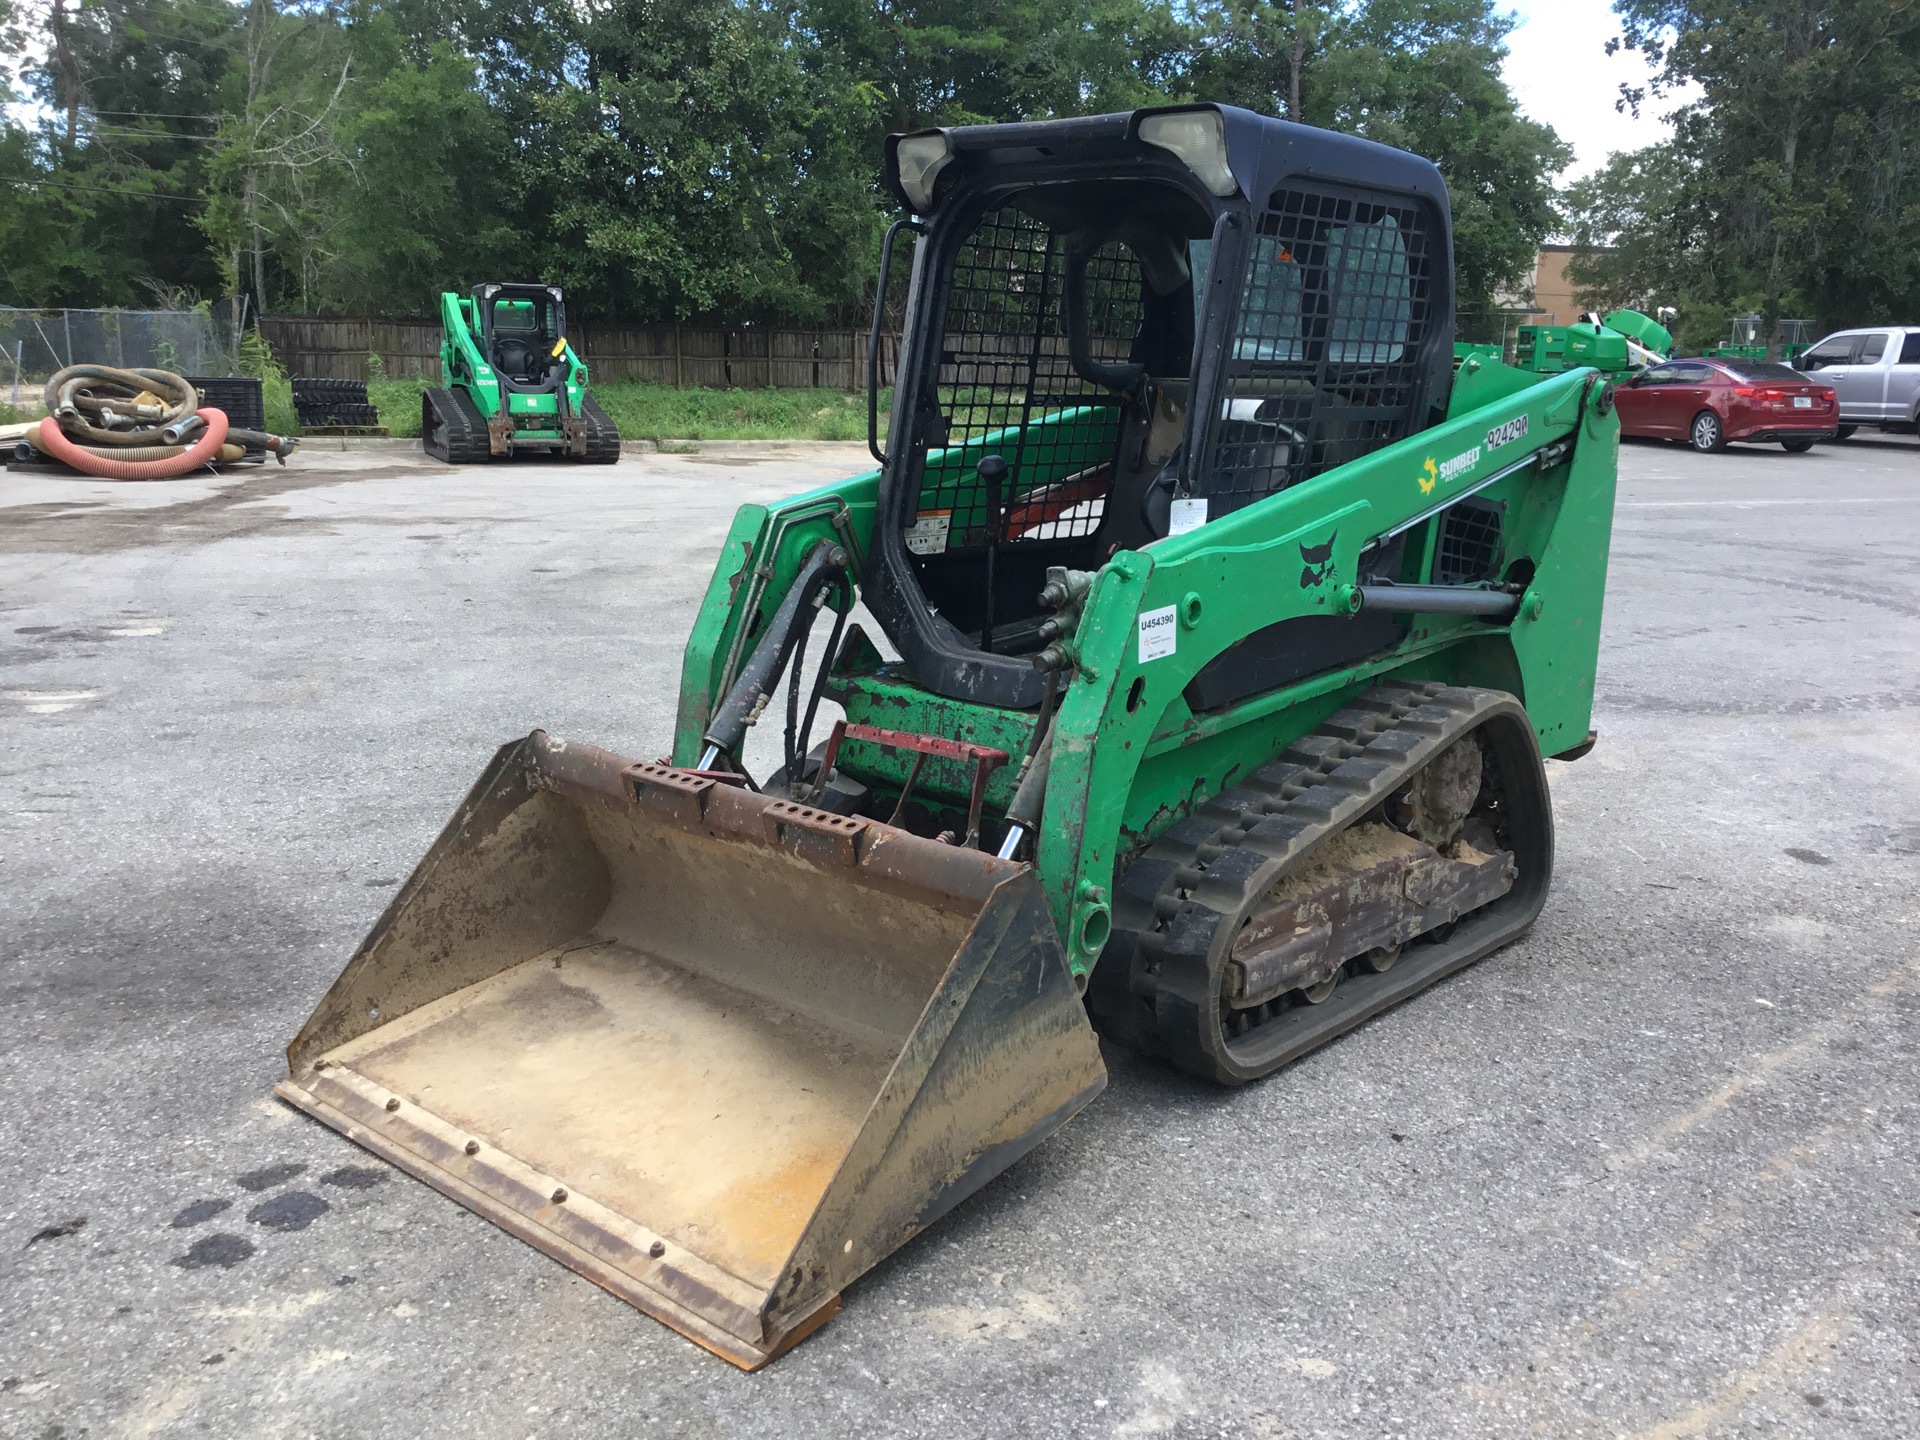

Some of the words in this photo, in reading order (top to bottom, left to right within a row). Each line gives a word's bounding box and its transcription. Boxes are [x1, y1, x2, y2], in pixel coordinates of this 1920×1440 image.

[1439, 445, 1482, 480] SUNBELT
[1445, 463, 1476, 483] RENTALS
[1141, 613, 1174, 631] U454390
